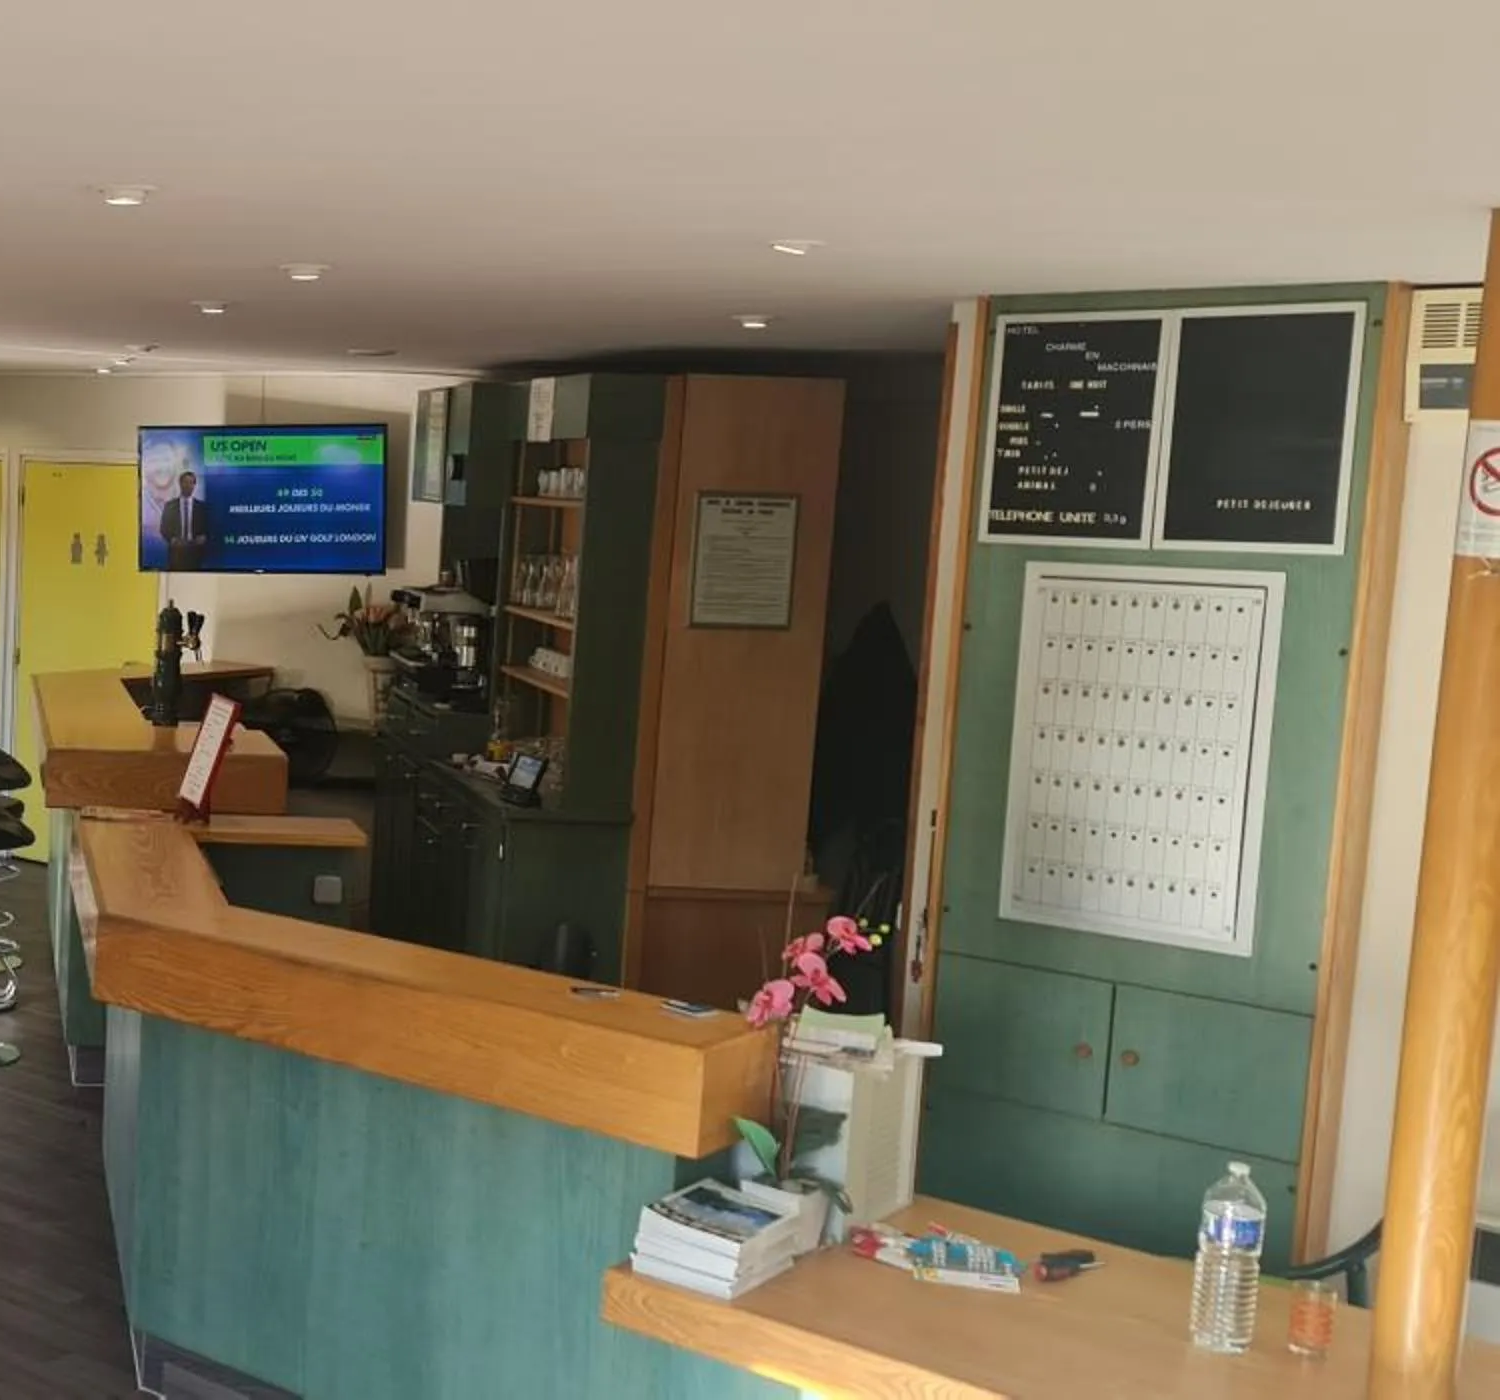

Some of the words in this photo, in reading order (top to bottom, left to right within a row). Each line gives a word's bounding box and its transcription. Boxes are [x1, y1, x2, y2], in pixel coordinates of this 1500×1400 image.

[210, 439, 228, 452] US
[231, 439, 267, 452] OPEN
[277, 503, 319, 513] JOUEURS
[1217, 499, 1248, 509] PETIT
[989, 510, 1054, 523] TELEPHONE
[1059, 511, 1097, 523] UNITE
[280, 534, 293, 543] DU
[335, 532, 377, 543] LONDON
